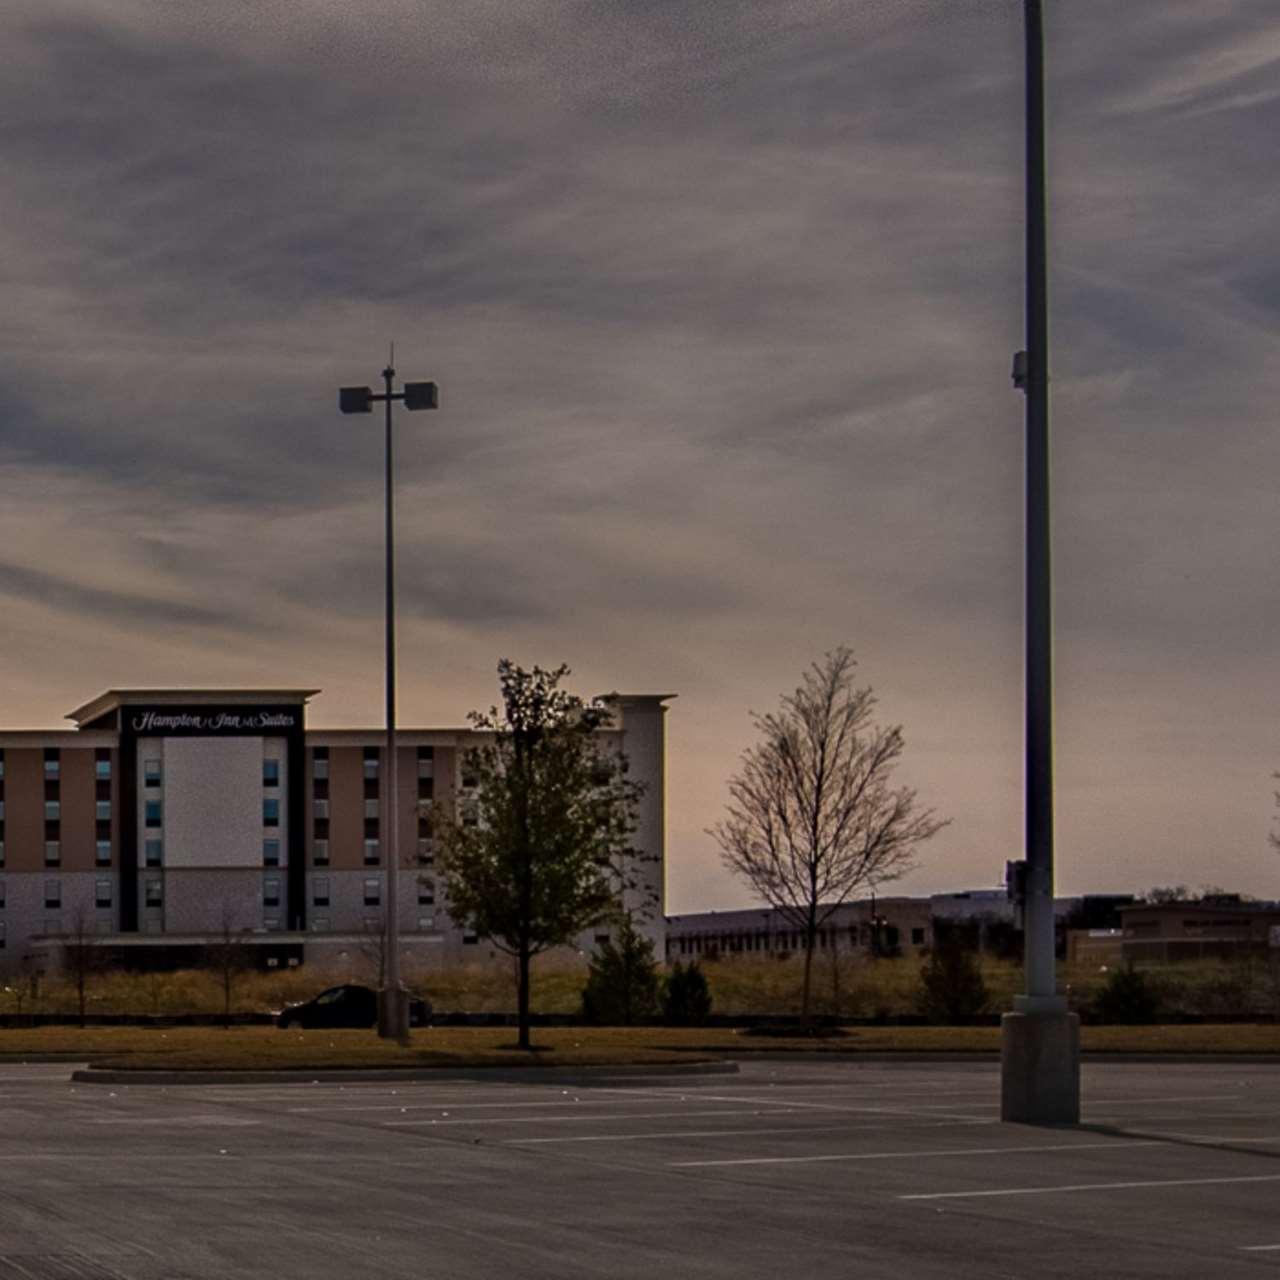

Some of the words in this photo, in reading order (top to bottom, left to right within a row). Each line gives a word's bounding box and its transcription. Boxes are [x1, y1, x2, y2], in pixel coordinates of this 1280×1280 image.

[132, 711, 207, 731] Hampton
[208, 711, 244, 730] Inn
[257, 711, 295, 728] Suites
